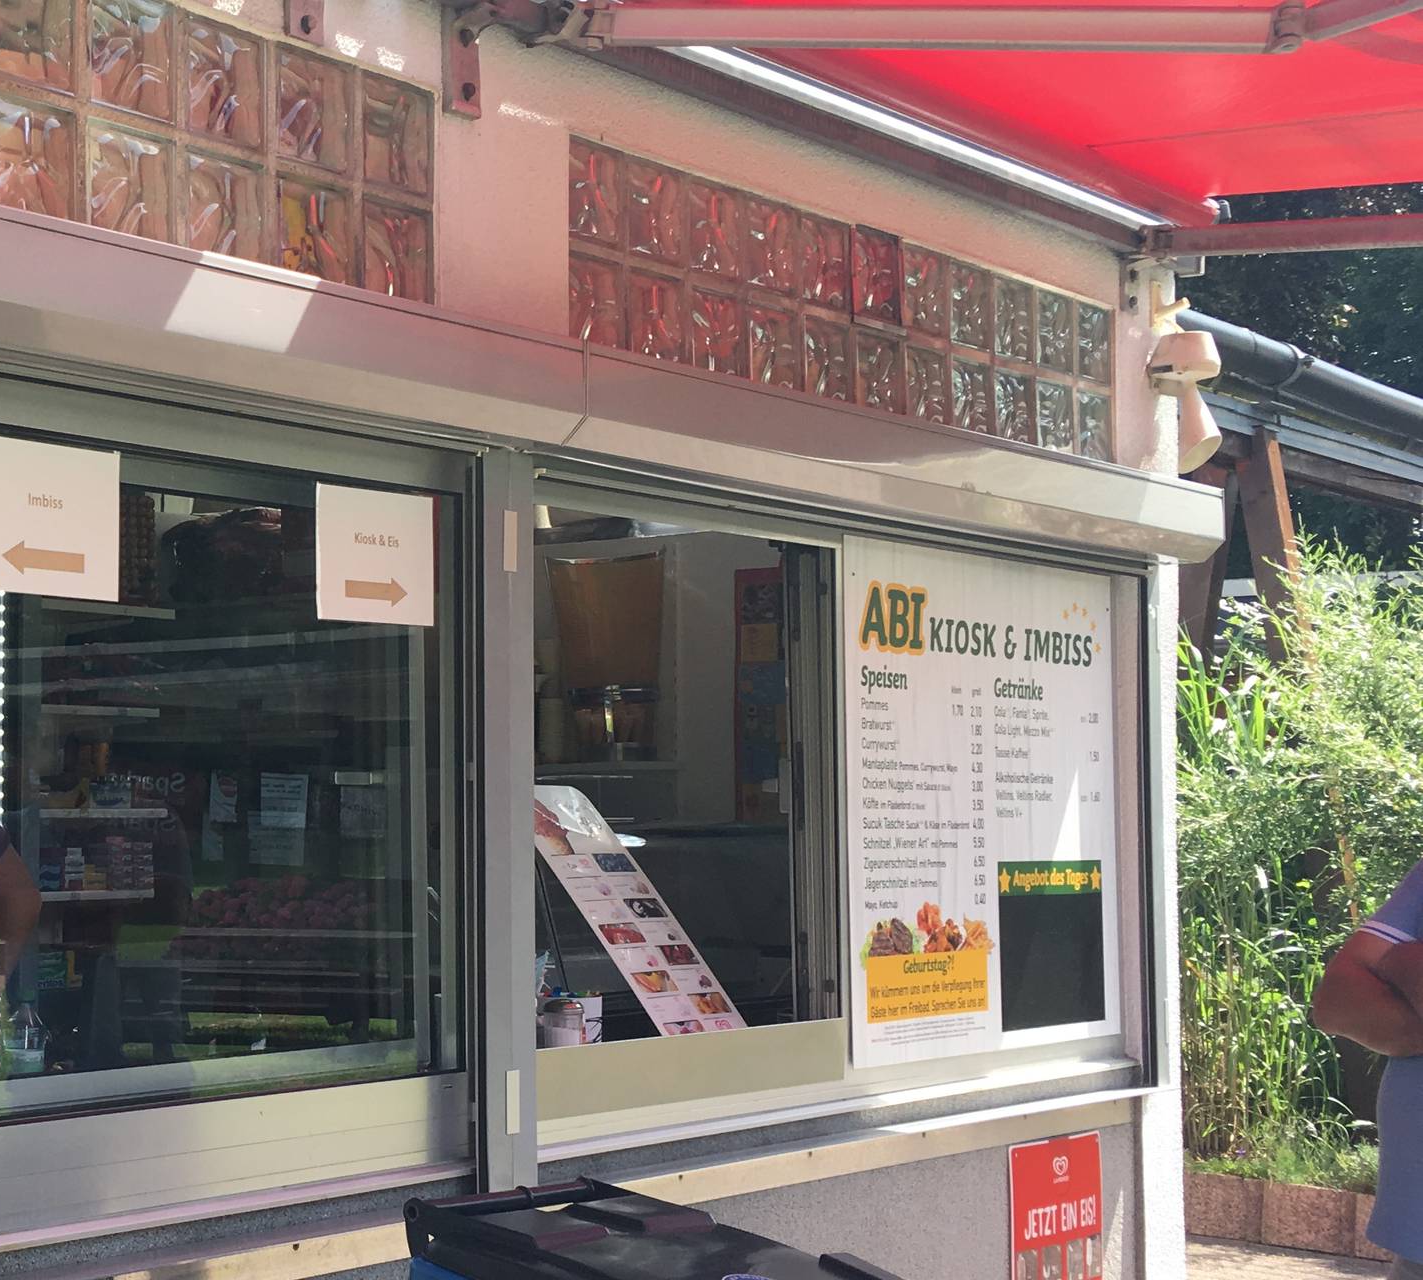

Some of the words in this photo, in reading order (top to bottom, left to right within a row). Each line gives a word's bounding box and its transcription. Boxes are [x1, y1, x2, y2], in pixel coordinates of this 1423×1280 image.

[27, 491, 64, 511] Imbiss
[353, 531, 376, 547] Kiosk
[378, 535, 385, 547] &
[387, 535, 400, 549] Eis
[860, 583, 927, 653] ABI
[929, 616, 997, 658] KIOSK
[1004, 625, 1018, 660] &
[1023, 628, 1093, 667] IMBISS
[860, 665, 908, 694] Speisen
[994, 677, 1044, 702] Getränke
[860, 696, 889, 711] Pommes
[1013, 867, 1050, 892] Angebot
[1049, 867, 1065, 886] des
[1065, 868, 1089, 891] Tages
[903, 955, 955, 976] Geburtstag?!
[1024, 1204, 1058, 1241] JETZT
[1061, 1200, 1078, 1232] EIN
[1080, 1194, 1097, 1227] EIS!
